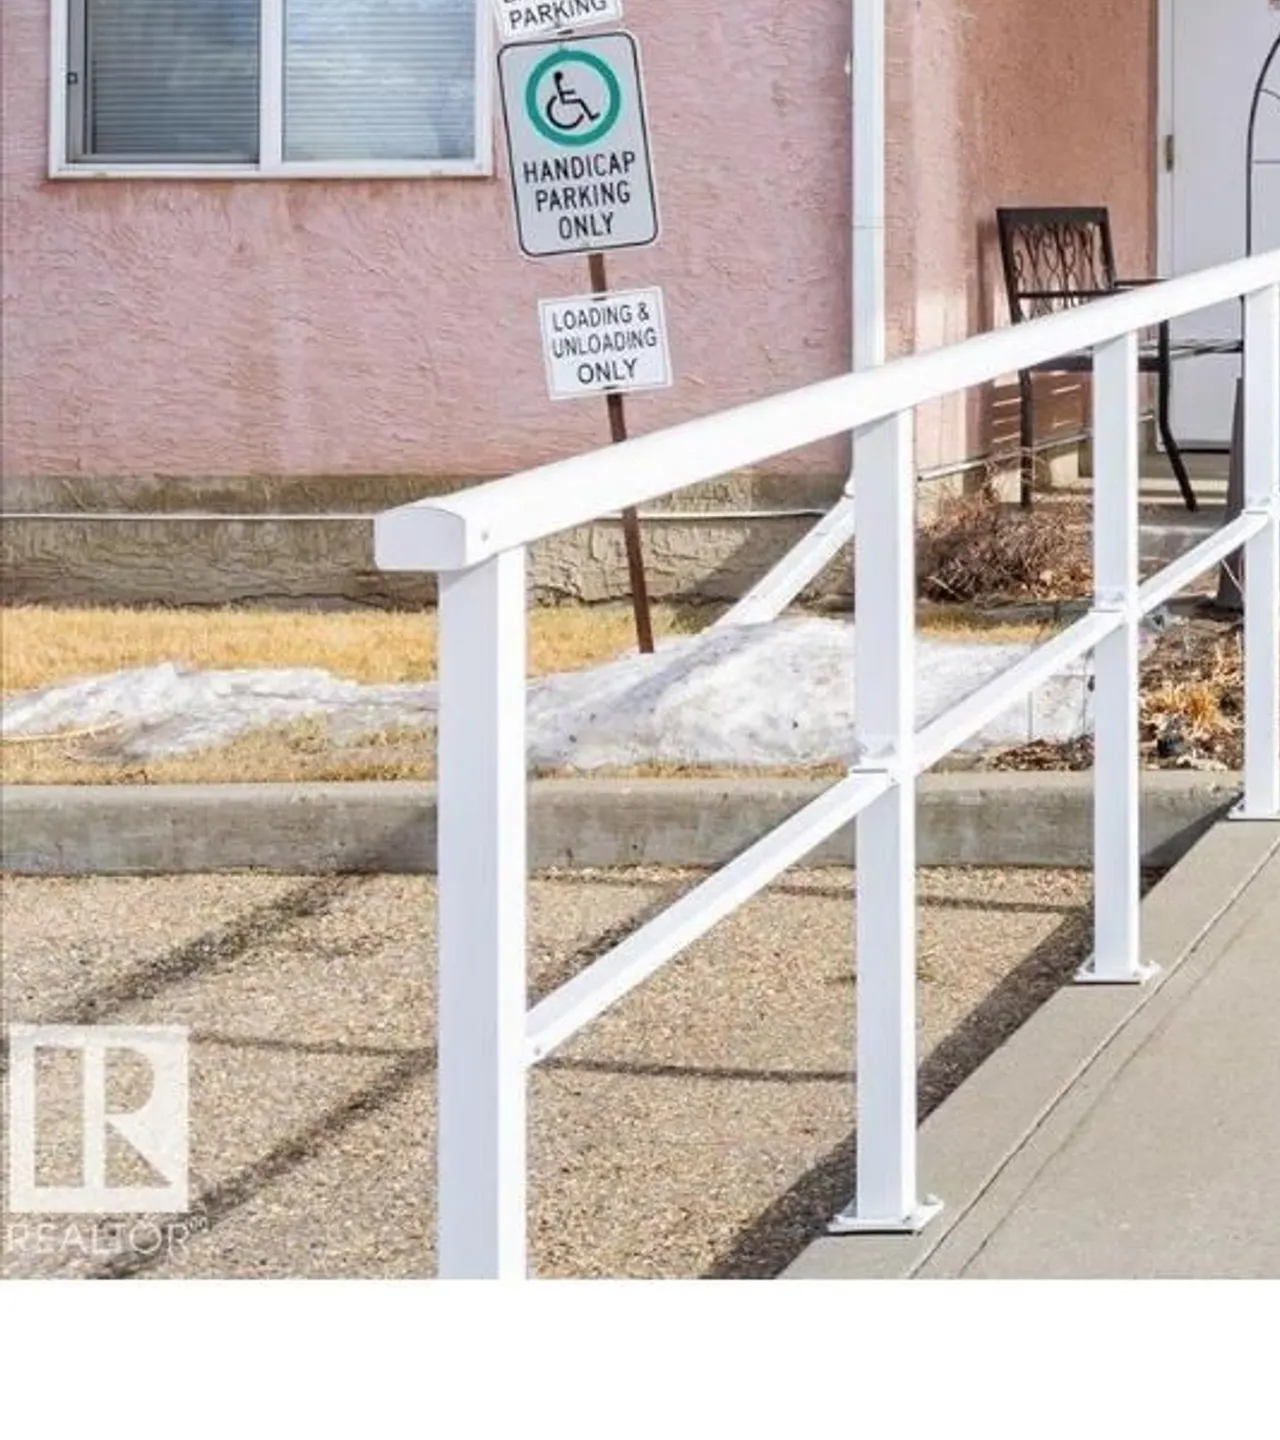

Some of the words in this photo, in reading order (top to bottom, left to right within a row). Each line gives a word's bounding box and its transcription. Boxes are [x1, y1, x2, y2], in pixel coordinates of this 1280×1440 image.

[523, 151, 635, 183] HANDICAP
[535, 180, 630, 212] PARKING
[558, 211, 613, 240] ONLY
[552, 304, 632, 333] LOADING
[638, 302, 649, 321] &
[552, 327, 657, 358] UNLOADING
[577, 358, 637, 385] ONLY
